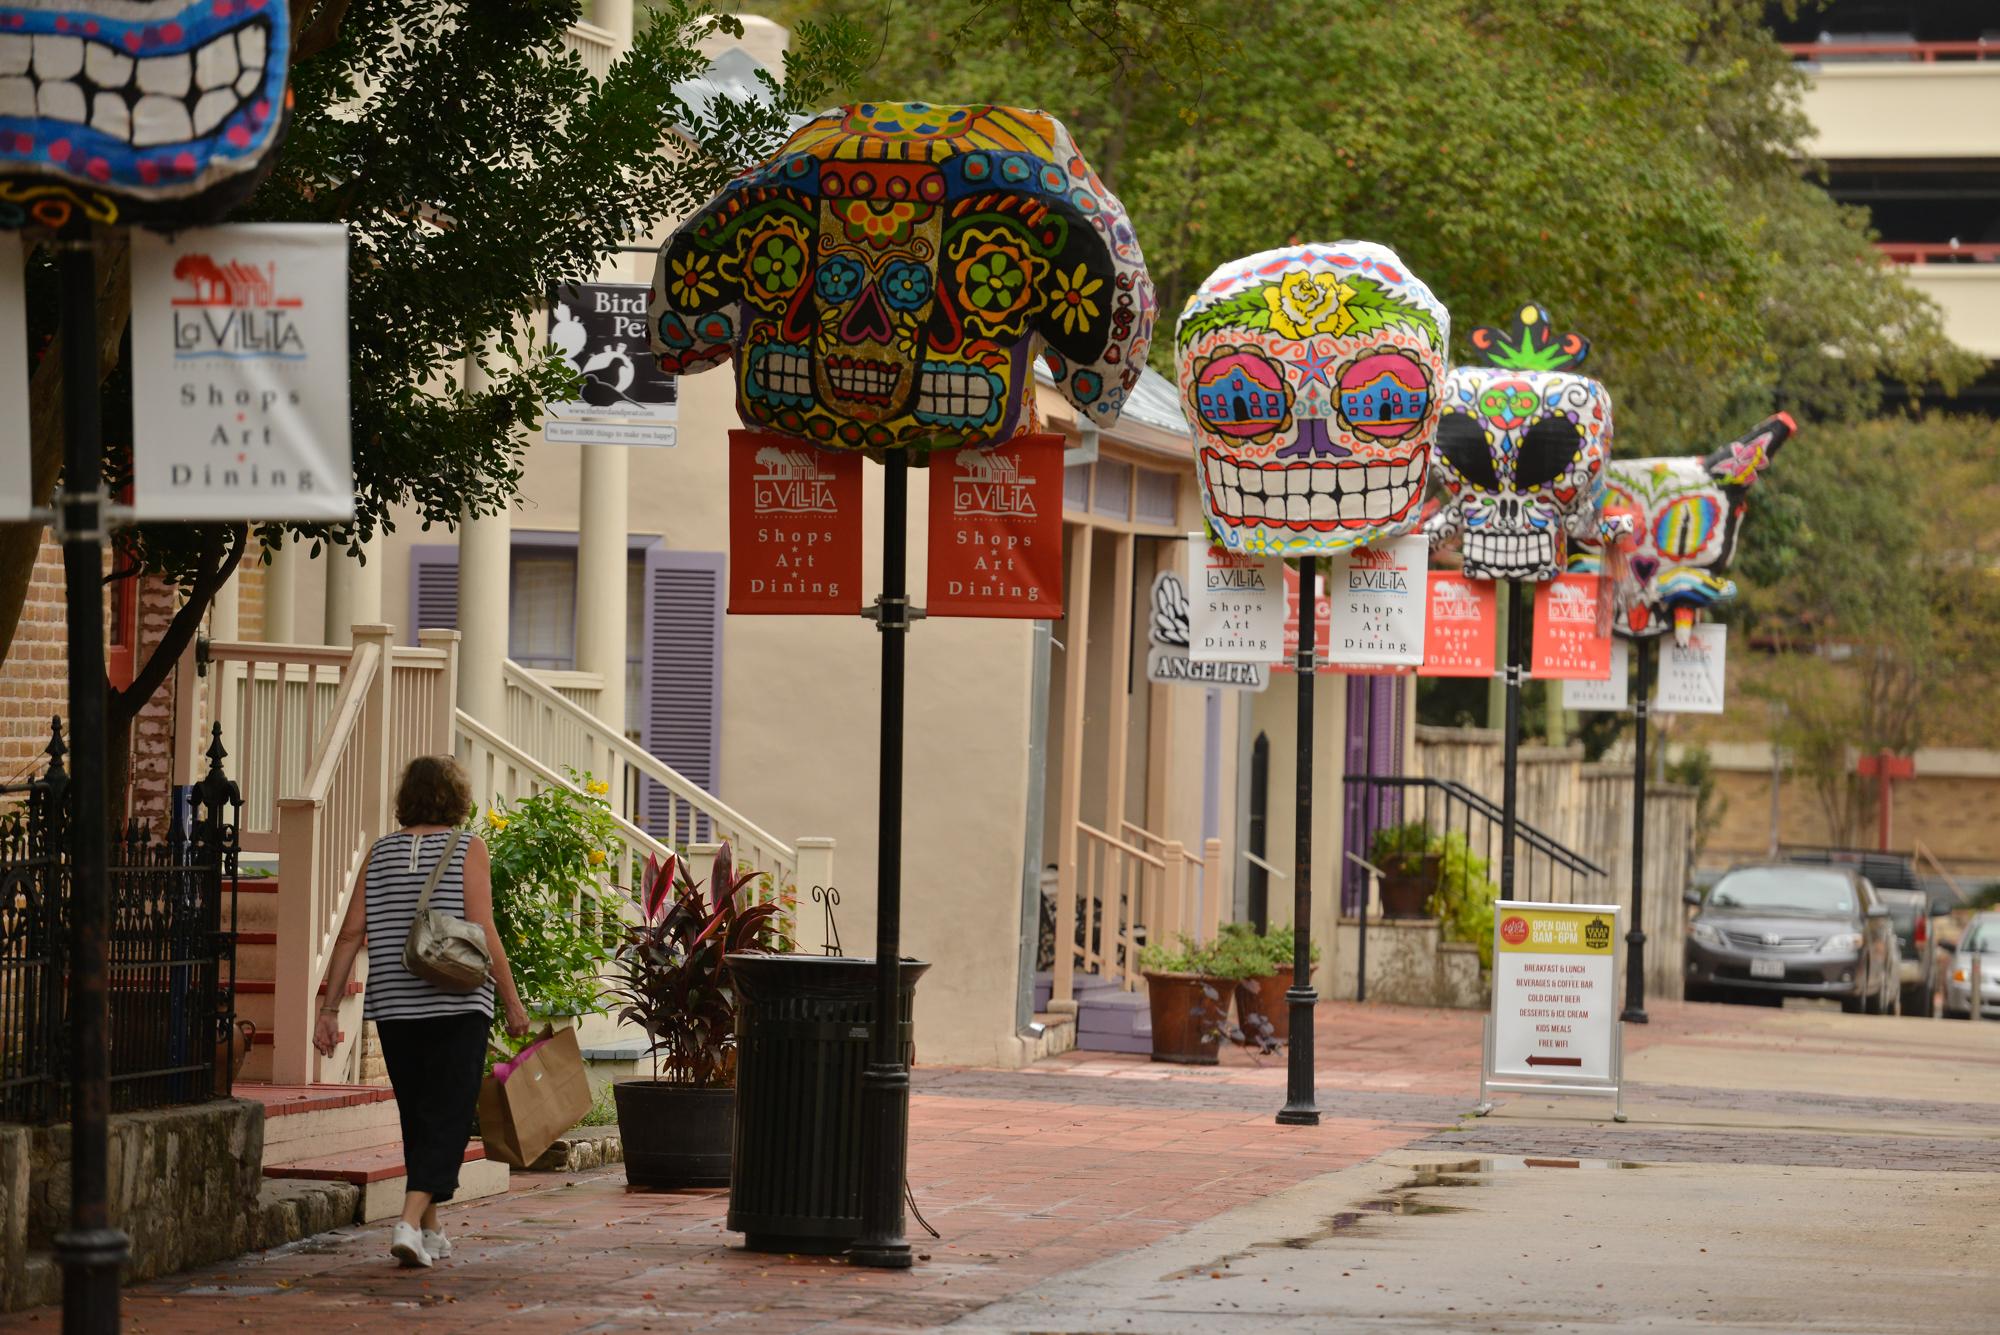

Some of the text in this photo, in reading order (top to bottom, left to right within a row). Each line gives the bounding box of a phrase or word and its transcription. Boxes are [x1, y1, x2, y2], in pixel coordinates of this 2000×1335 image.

[594, 292, 647, 314] Bird
[181, 384, 300, 412] Shops
[211, 424, 271, 445] Art
[172, 464, 313, 491] Dining
[758, 528, 832, 546] Shops
[956, 530, 1032, 550] Shops
[776, 553, 814, 567] Art
[974, 556, 1014, 570] Art
[751, 579, 839, 598] Dining
[948, 582, 1039, 601] Dining
[1210, 602, 1262, 614] Shops
[1350, 603, 1404, 616] Shops
[1223, 620, 1249, 629] Art
[1362, 622, 1390, 631] Art
[1434, 626, 1478, 638] Shops
[1550, 628, 1594, 642] Shops
[1205, 638, 1267, 650] Dining
[1344, 638, 1408, 652] Dining
[1444, 641, 1468, 651] Art
[1560, 643, 1582, 654] Art
[1430, 655, 1482, 668] Dining
[1544, 656, 1596, 670] Dining
[1155, 656, 1260, 685] ANGELITA
[1532, 920, 1552, 931] OPEN
[1555, 920, 1578, 932] DAILY
[1524, 964, 1558, 973] BREAKFAST
[1566, 965, 1586, 974] LUNCH
[1516, 978, 1550, 988] BEVERAGES
[1558, 980, 1580, 988] COFFEE
[1581, 981, 1594, 989] BAR
[1528, 994, 1580, 1004] COLD CRAFT BEER
[1520, 1009, 1550, 1017] DESSERTS
[1556, 1010, 1566, 1018] ICE
[1568, 1010, 1588, 1018] CREAM
[1536, 1024, 1572, 1032] KIDS MEALS
[1538, 1040, 1568, 1048] FREE WIFI
